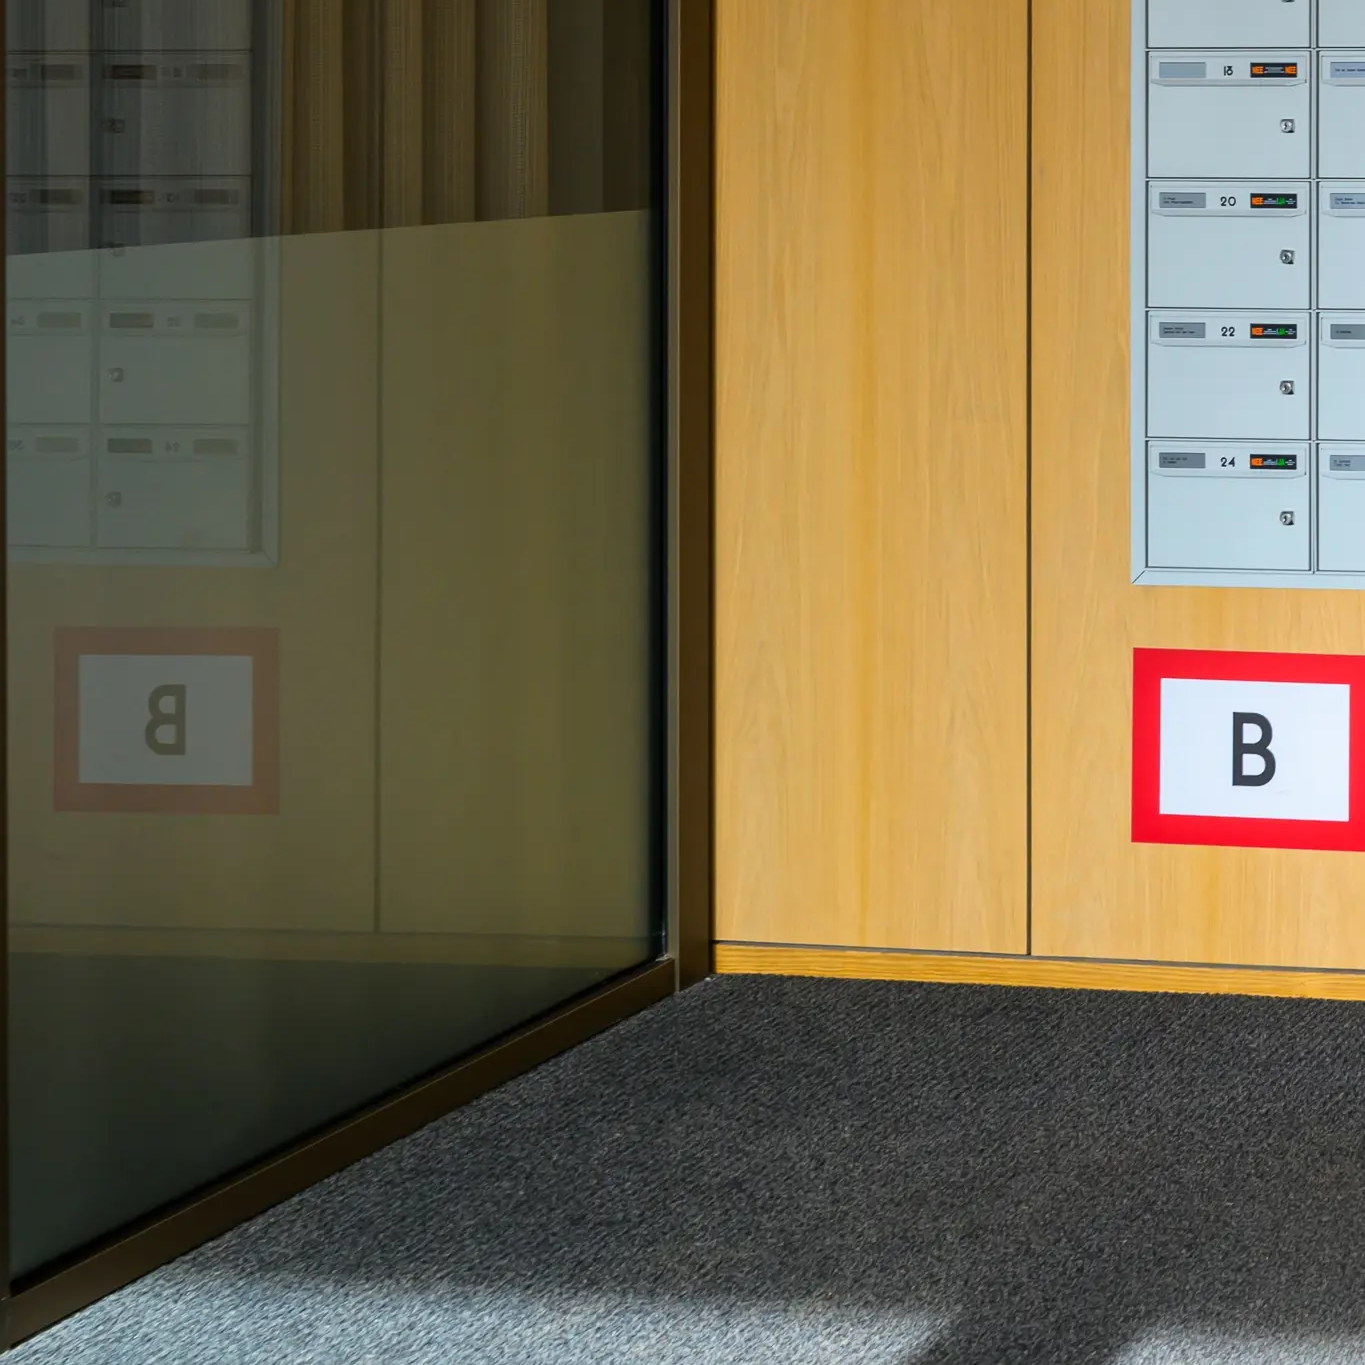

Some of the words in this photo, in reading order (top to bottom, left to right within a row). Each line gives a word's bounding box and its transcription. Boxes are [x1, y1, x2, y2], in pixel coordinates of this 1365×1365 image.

[1223, 65, 1234, 77] 18
[1219, 196, 1237, 207] 20
[1220, 326, 1236, 337] 22
[1220, 456, 1236, 468] 24
[1232, 711, 1276, 787] B
